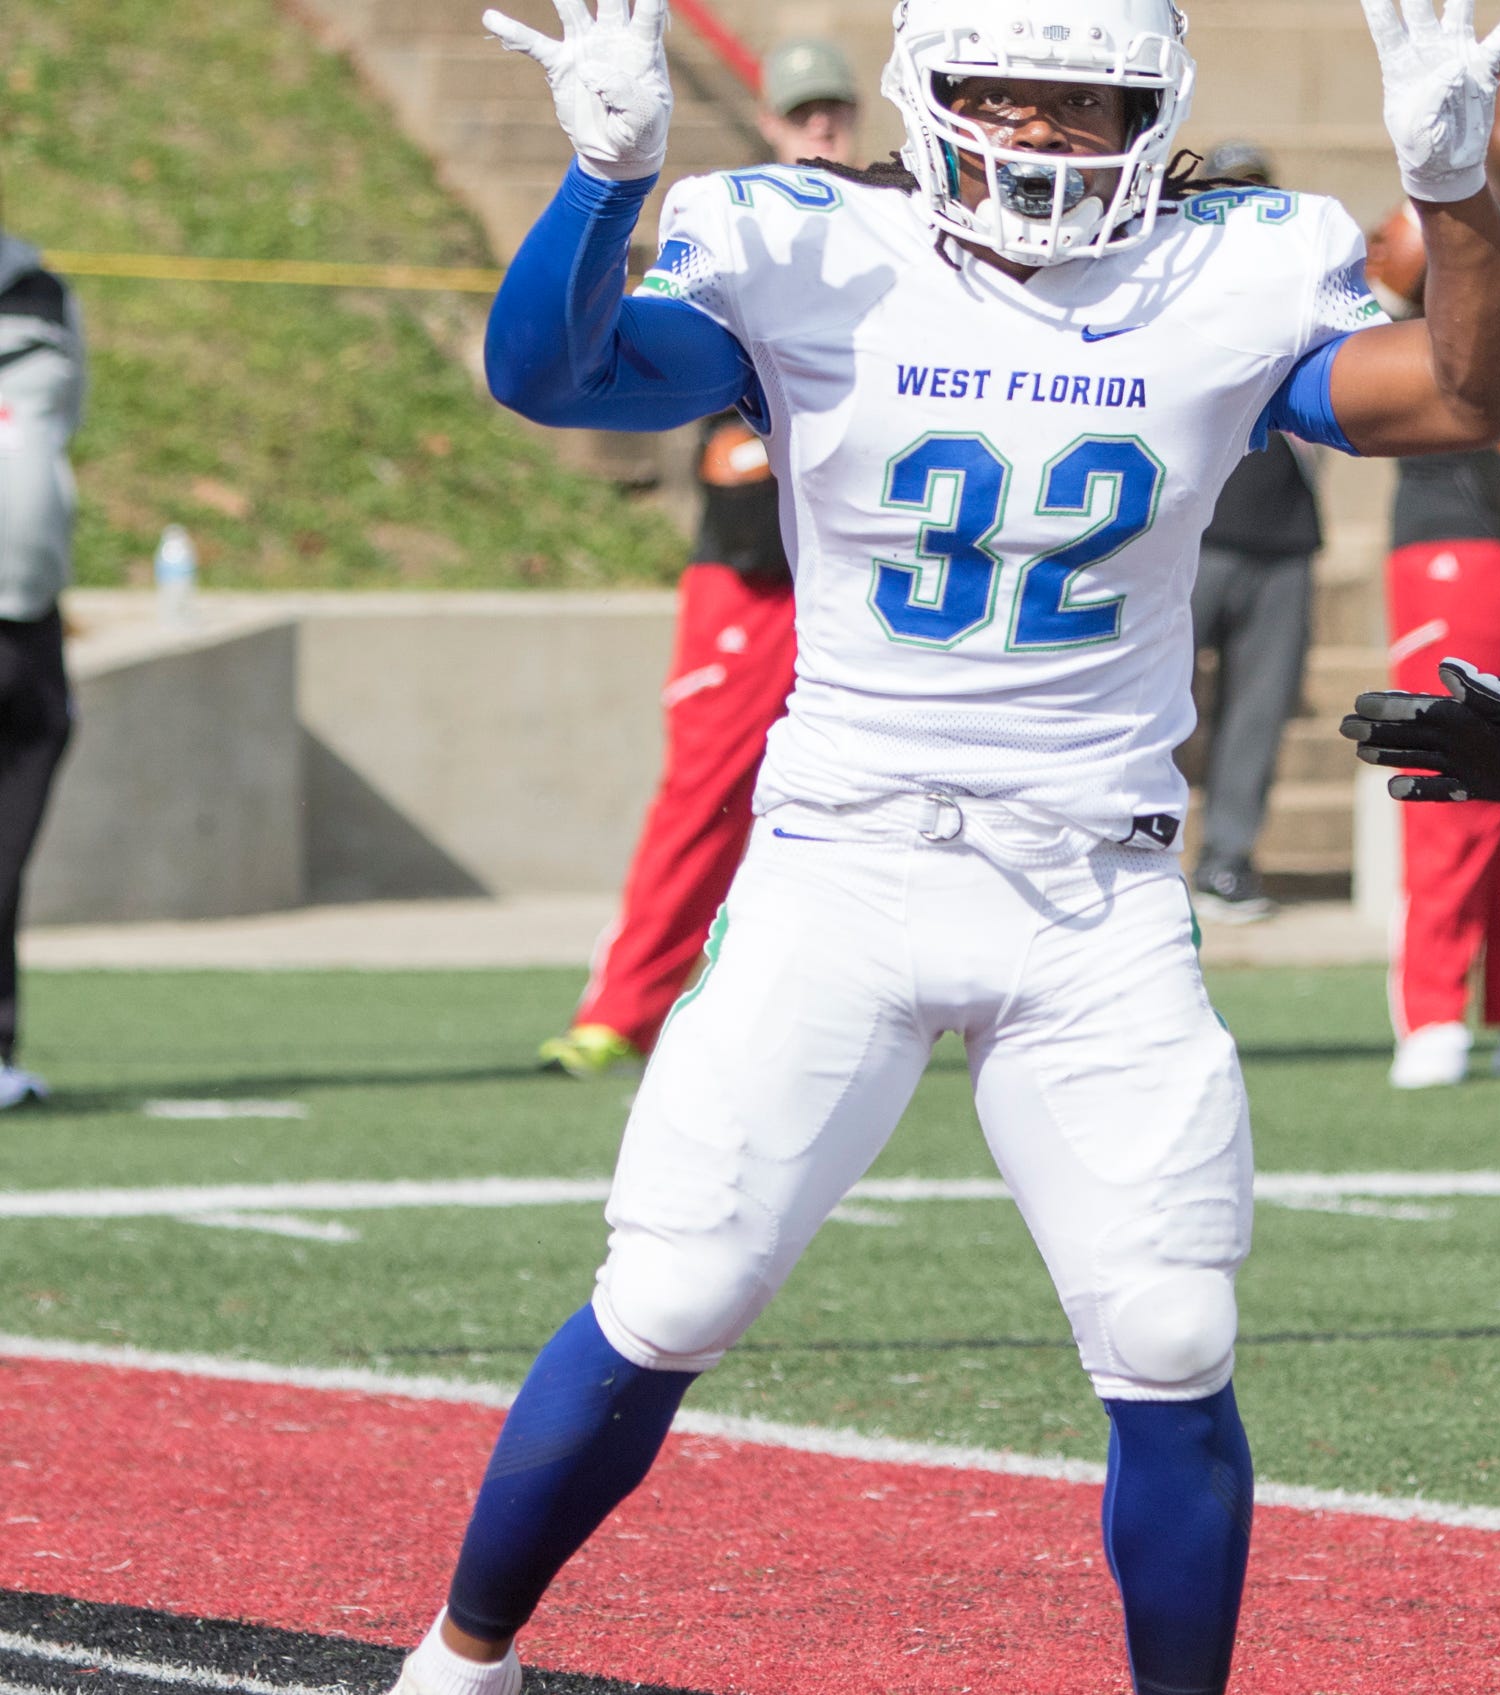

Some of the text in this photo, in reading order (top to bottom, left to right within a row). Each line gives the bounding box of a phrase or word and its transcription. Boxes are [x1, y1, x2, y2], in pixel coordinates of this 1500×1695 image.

[897, 364, 1147, 408] WEST FLORIDA
[866, 430, 1167, 653] 32
[1152, 816, 1164, 836] L
